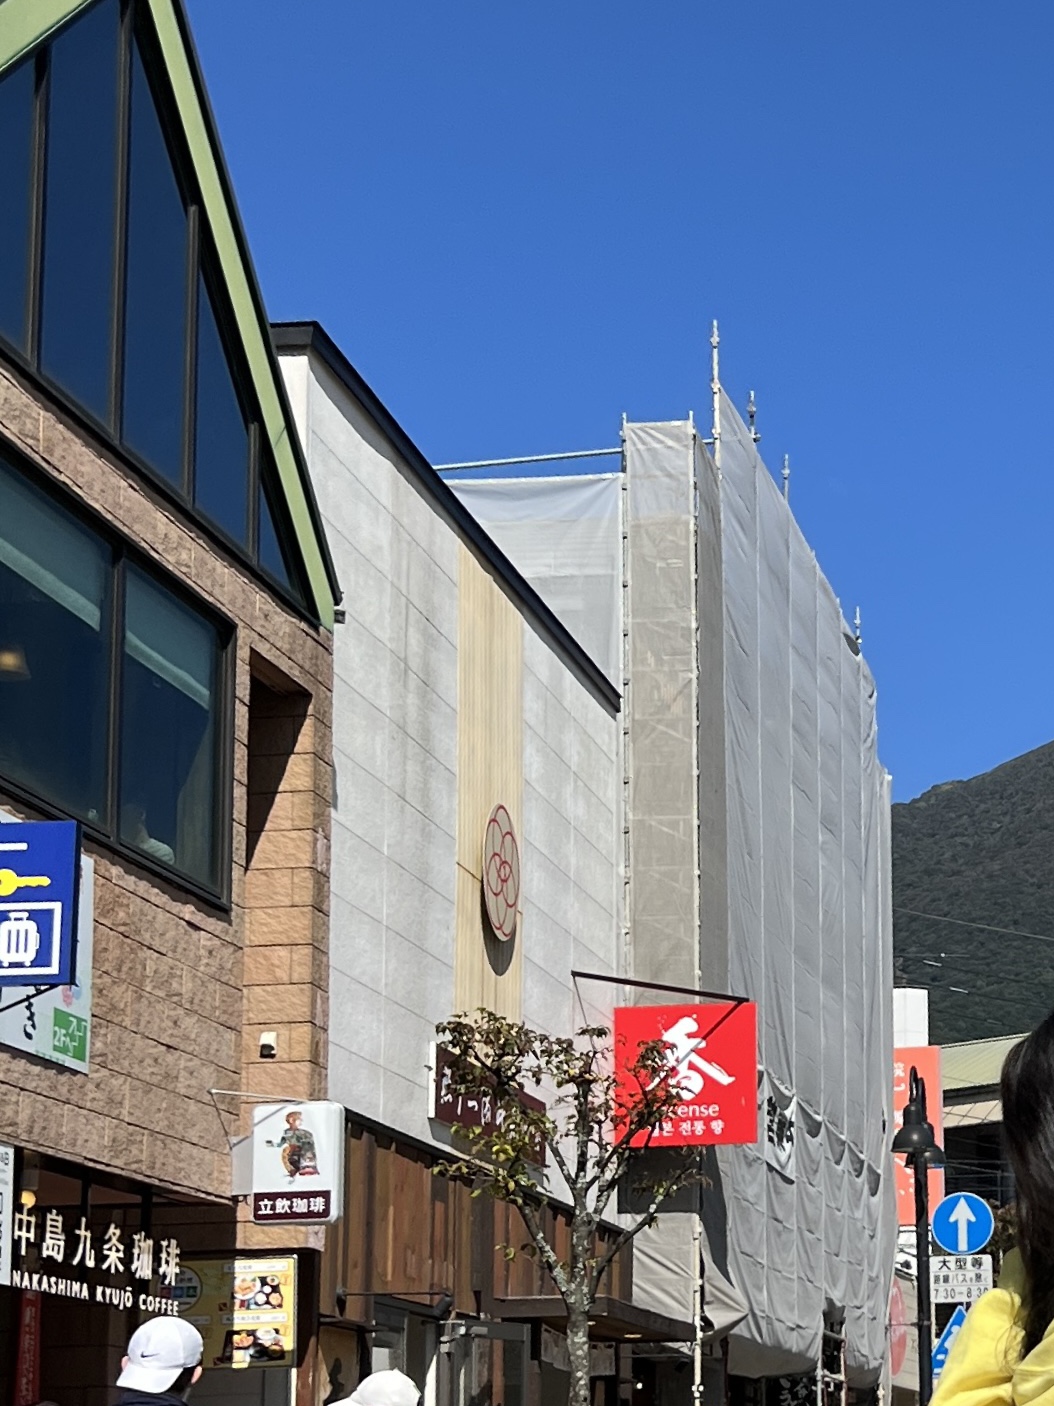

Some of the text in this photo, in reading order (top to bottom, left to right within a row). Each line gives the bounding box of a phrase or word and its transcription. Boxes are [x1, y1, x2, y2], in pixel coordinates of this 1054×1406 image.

[53, 1026, 67, 1048] 2F
[645, 1014, 736, 1101] 香
[660, 1103, 720, 1118] cense
[678, 1120, 706, 1136] 전통
[710, 1119, 725, 1135] 향
[257, 1196, 326, 1215] 立飲珈琲
[13, 1206, 181, 1286] 中島九条珈琲
[938, 1256, 983, 1271] 大型等
[12, 1270, 90, 1300] NAKASHIMA
[138, 1294, 179, 1316] COFFEE
